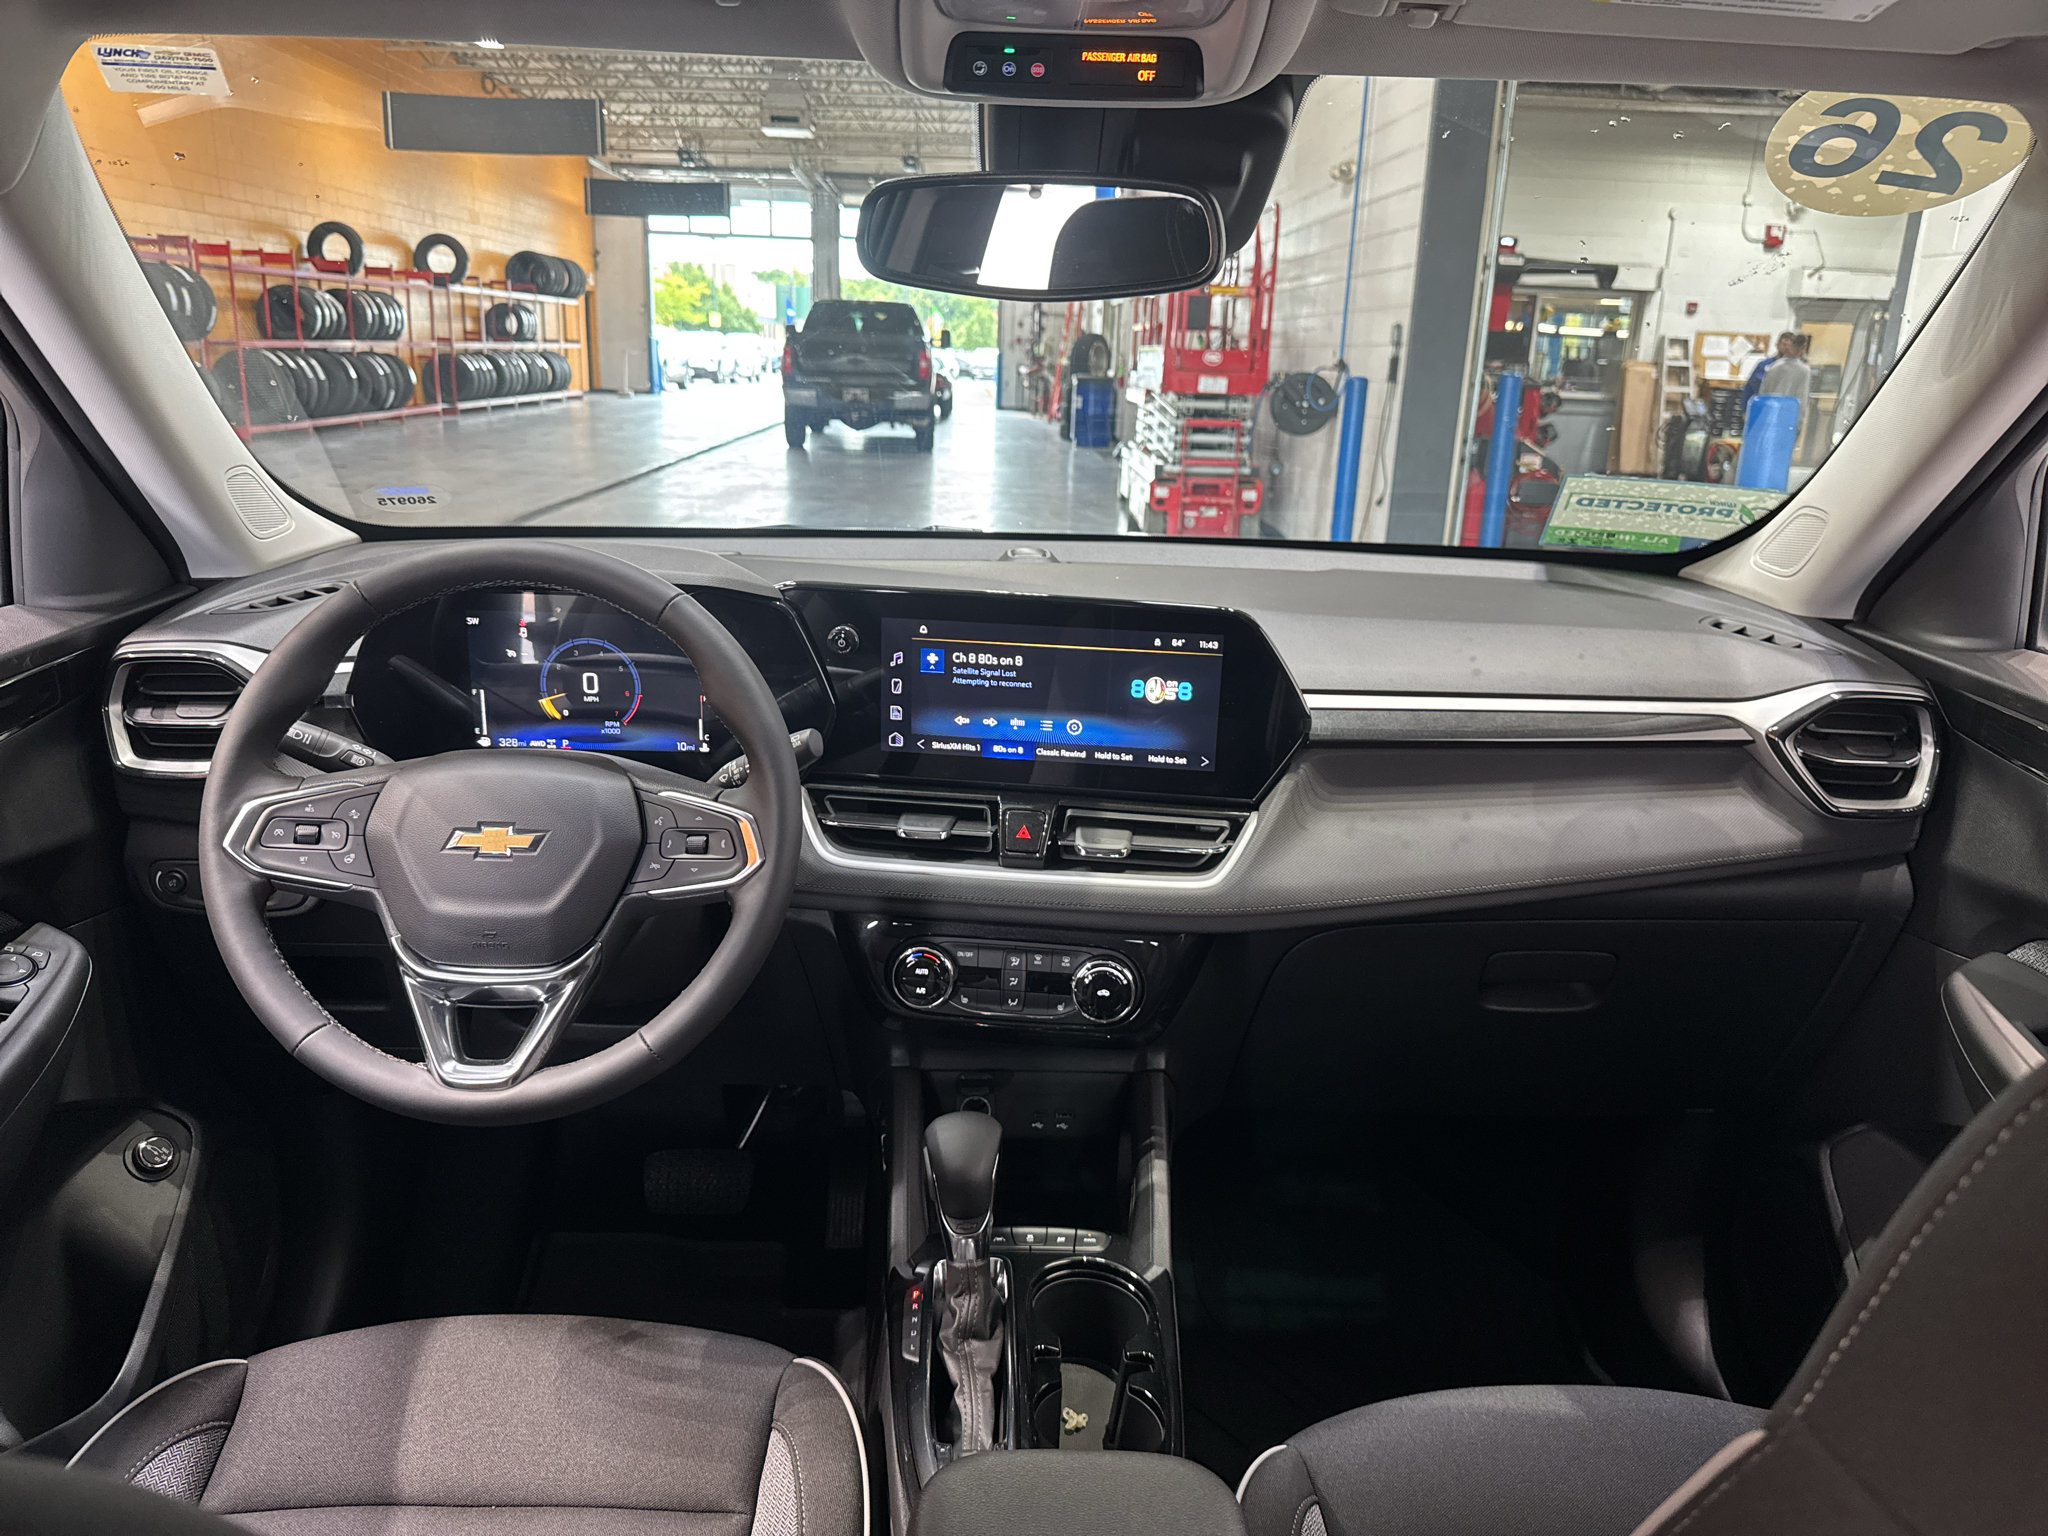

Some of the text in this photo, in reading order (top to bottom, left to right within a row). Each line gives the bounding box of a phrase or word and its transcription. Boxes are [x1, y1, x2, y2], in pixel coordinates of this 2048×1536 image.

[97, 47, 141, 58] LYNCH
[1082, 52, 1157, 63] PASSENGER AIR BAG
[1137, 70, 1156, 82] OFF
[126, 78, 194, 86] COMPLIMENTARY
[465, 617, 479, 625] SW
[1199, 640, 1219, 649] 11:43
[952, 652, 1023, 666] Ch 8 80s on 8
[952, 667, 1017, 678] Satellite Signal Lost
[582, 672, 599, 694] 0
[952, 677, 1032, 689] Attempting to reconnect
[932, 741, 961, 751] SiriusXM
[962, 743, 976, 751] Hits
[992, 745, 1007, 753] 80s
[1036, 748, 1086, 758] Classic Rewind
[1095, 751, 1111, 760] Hold
[1120, 753, 1133, 762] Set
[1148, 755, 1187, 765] Hold to Set
[912, 1290, 920, 1299] P
